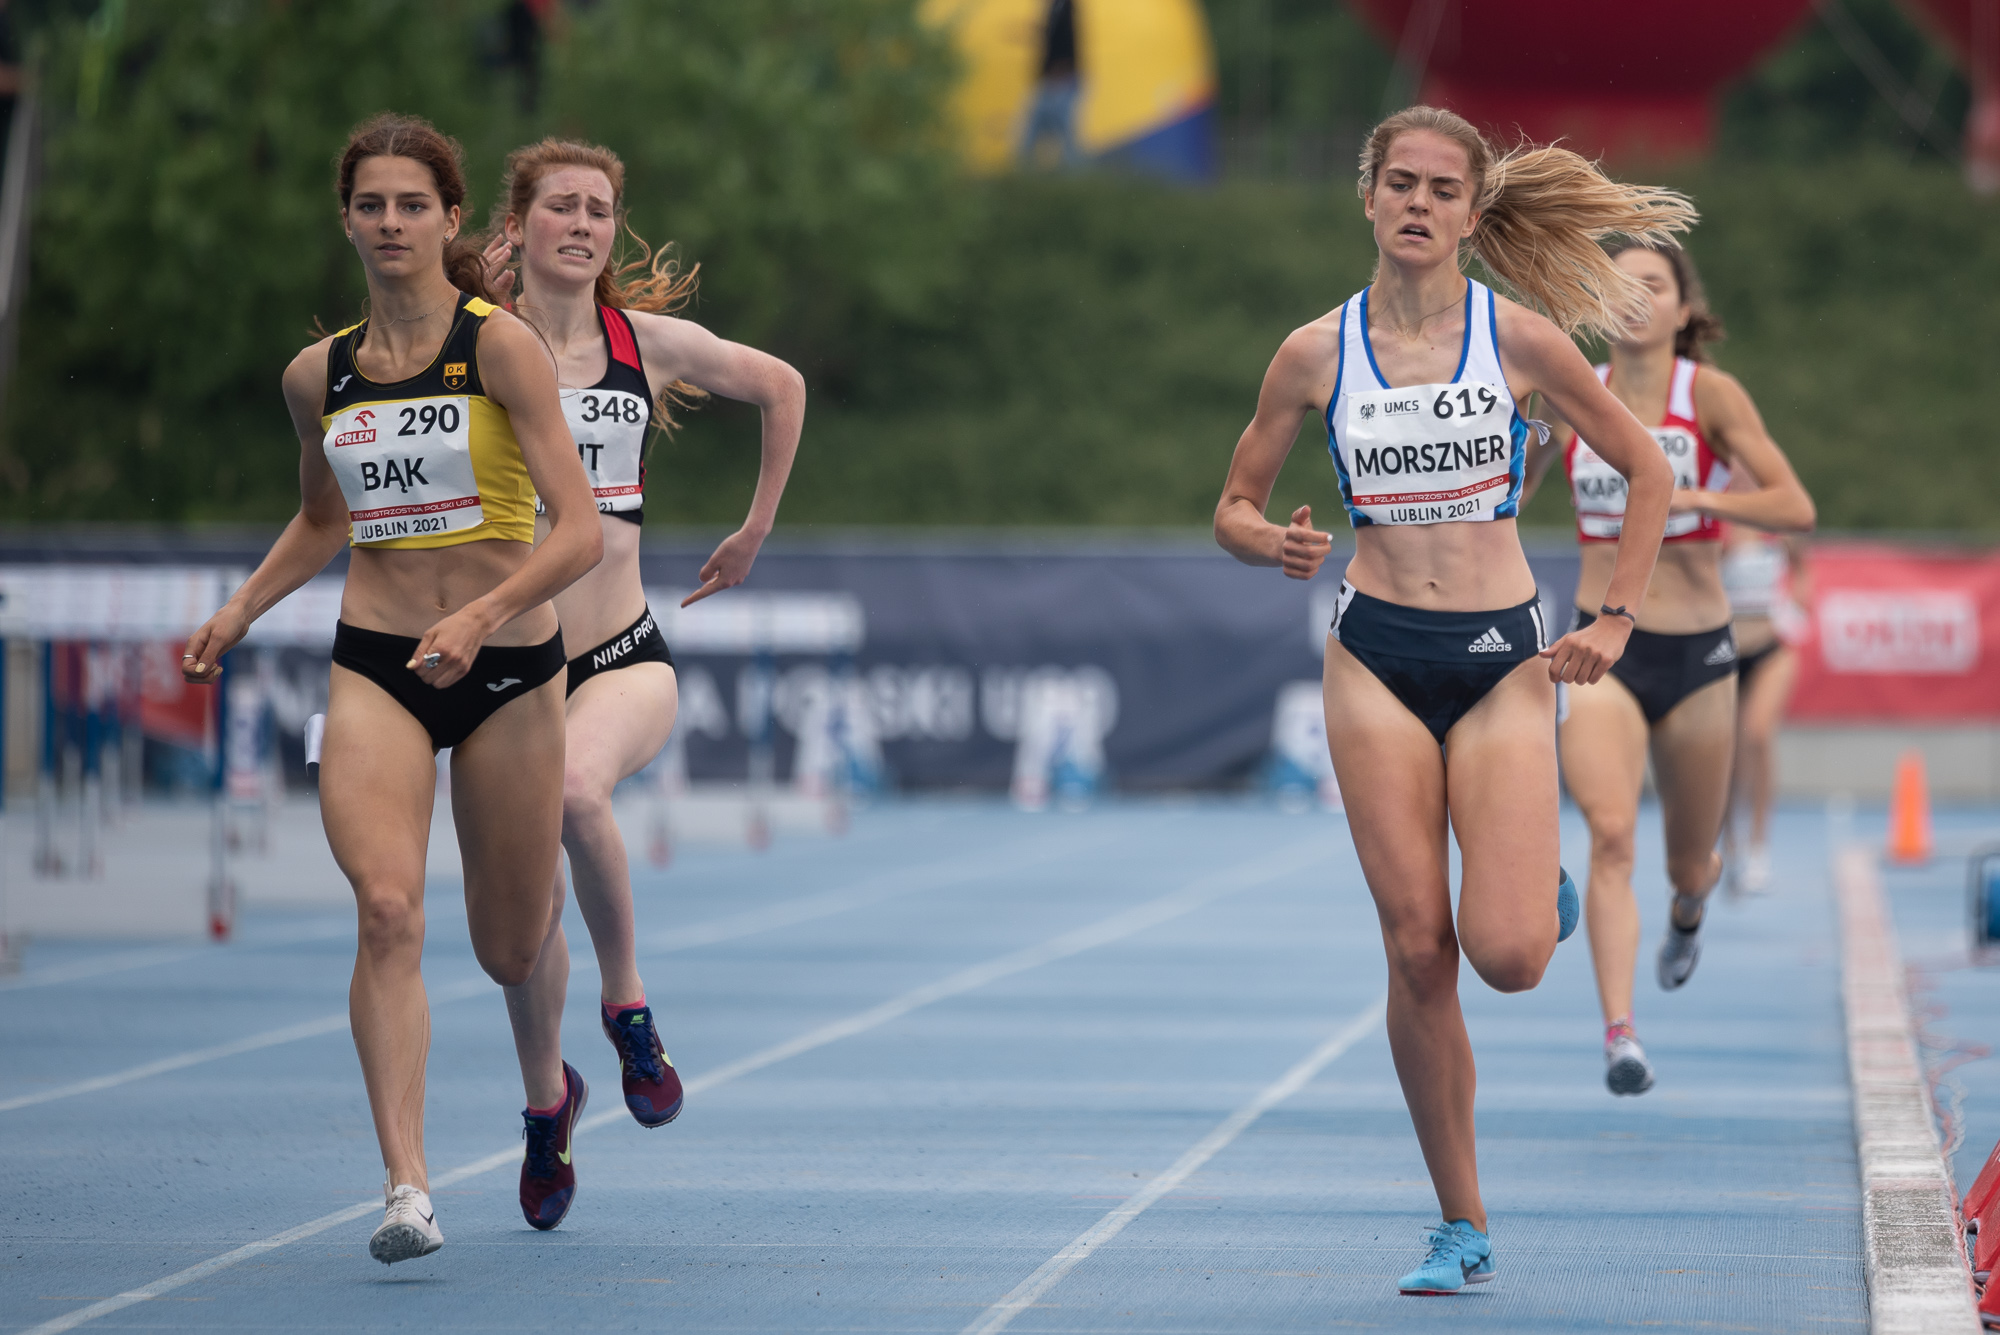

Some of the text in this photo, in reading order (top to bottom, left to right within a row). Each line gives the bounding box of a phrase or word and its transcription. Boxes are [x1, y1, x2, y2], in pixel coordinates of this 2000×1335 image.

[452, 377, 458, 386] S
[581, 395, 641, 424] 348
[1384, 400, 1419, 413] UMCS
[1433, 387, 1498, 420] 619
[398, 404, 460, 437] 290
[336, 430, 375, 446] ORLEN
[1355, 434, 1506, 477] MORSZNER
[361, 457, 429, 493] BĄK
[597, 488, 619, 496] POLSKI
[1398, 491, 1460, 502] MISTRZOSTWA
[1461, 483, 1487, 496] POLSKI
[1489, 477, 1504, 487] U20
[365, 506, 424, 519] MISTRZOSTWA
[425, 502, 454, 512] POLSKI
[456, 498, 474, 507] U20
[1390, 498, 1480, 522] LUBLIN 2021
[361, 516, 448, 539] LUBLIN 2021
[593, 614, 653, 669] NIKE PRO
[1468, 643, 1512, 653] adidas
